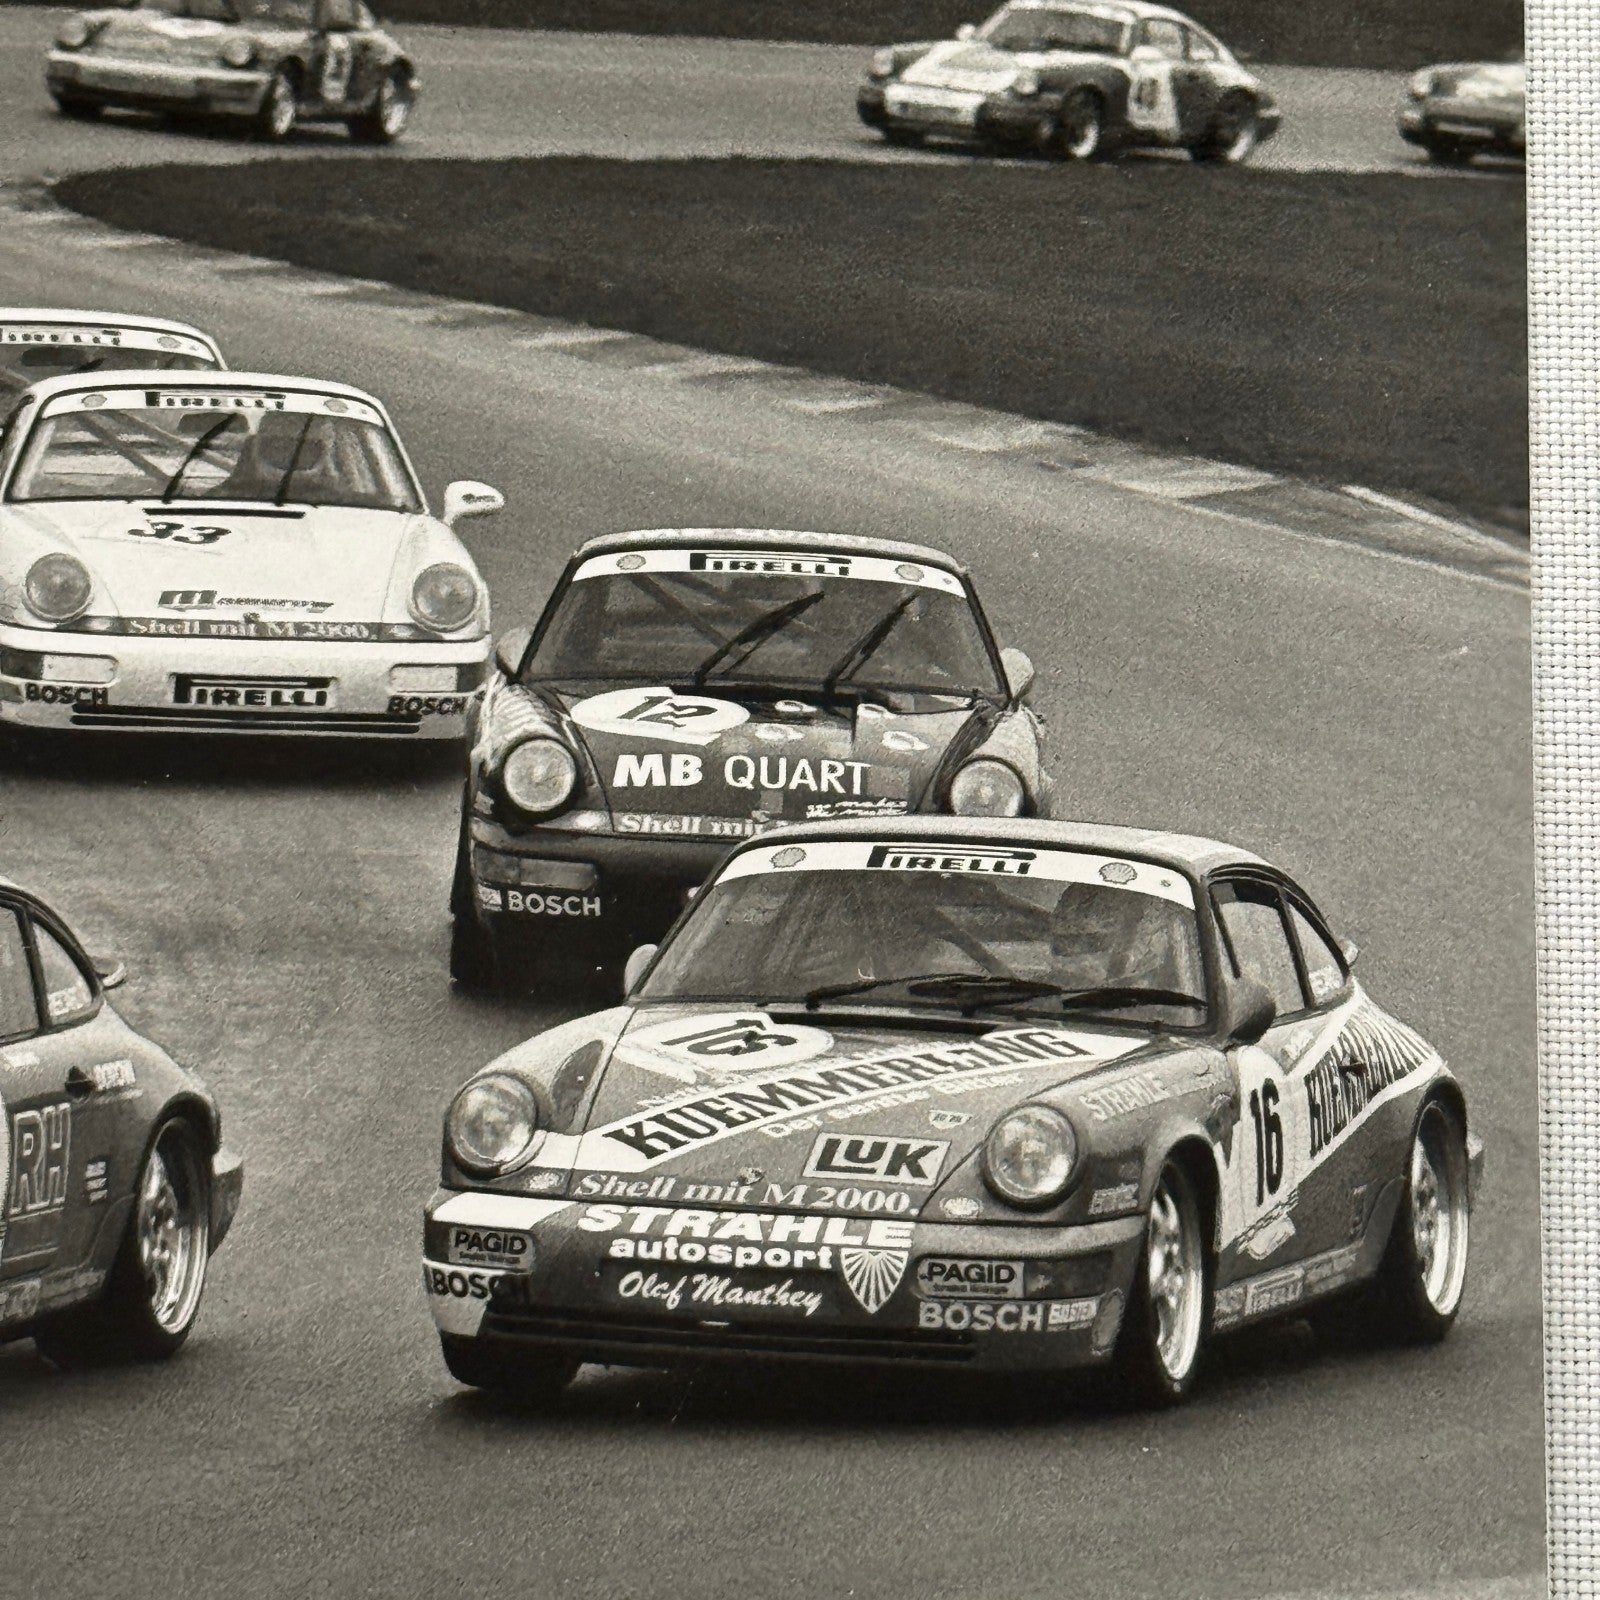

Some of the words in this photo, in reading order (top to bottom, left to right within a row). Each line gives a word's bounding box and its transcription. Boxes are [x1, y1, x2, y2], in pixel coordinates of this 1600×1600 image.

[145, 391, 285, 410] PIRELLI
[127, 519, 232, 545] 33
[690, 553, 852, 576] PIRELLI
[130, 619, 200, 635] Shell
[25, 682, 108, 705] BOSCH
[173, 673, 336, 706] PIRELLI
[388, 695, 466, 716] BOSCH
[617, 696, 718, 728] 12
[613, 753, 702, 788] MB
[724, 754, 871, 795] QUART
[616, 813, 702, 835] Shell
[867, 845, 1037, 875] PIRELLI
[507, 890, 601, 917] BOSCH
[602, 1031, 1095, 1160] KUEMMERLING
[1250, 1078, 1284, 1207] 16
[574, 1174, 677, 1199] Shell
[683, 1180, 753, 1204] mit
[760, 1183, 809, 1207] M
[809, 1186, 921, 1217] 2000.
[454, 1229, 528, 1256] PAGID
[608, 1236, 834, 1270] autosport
[928, 1261, 1016, 1284] PAGID
[691, 1274, 824, 1318] Manthey
[918, 1301, 1045, 1332] BOSCH
